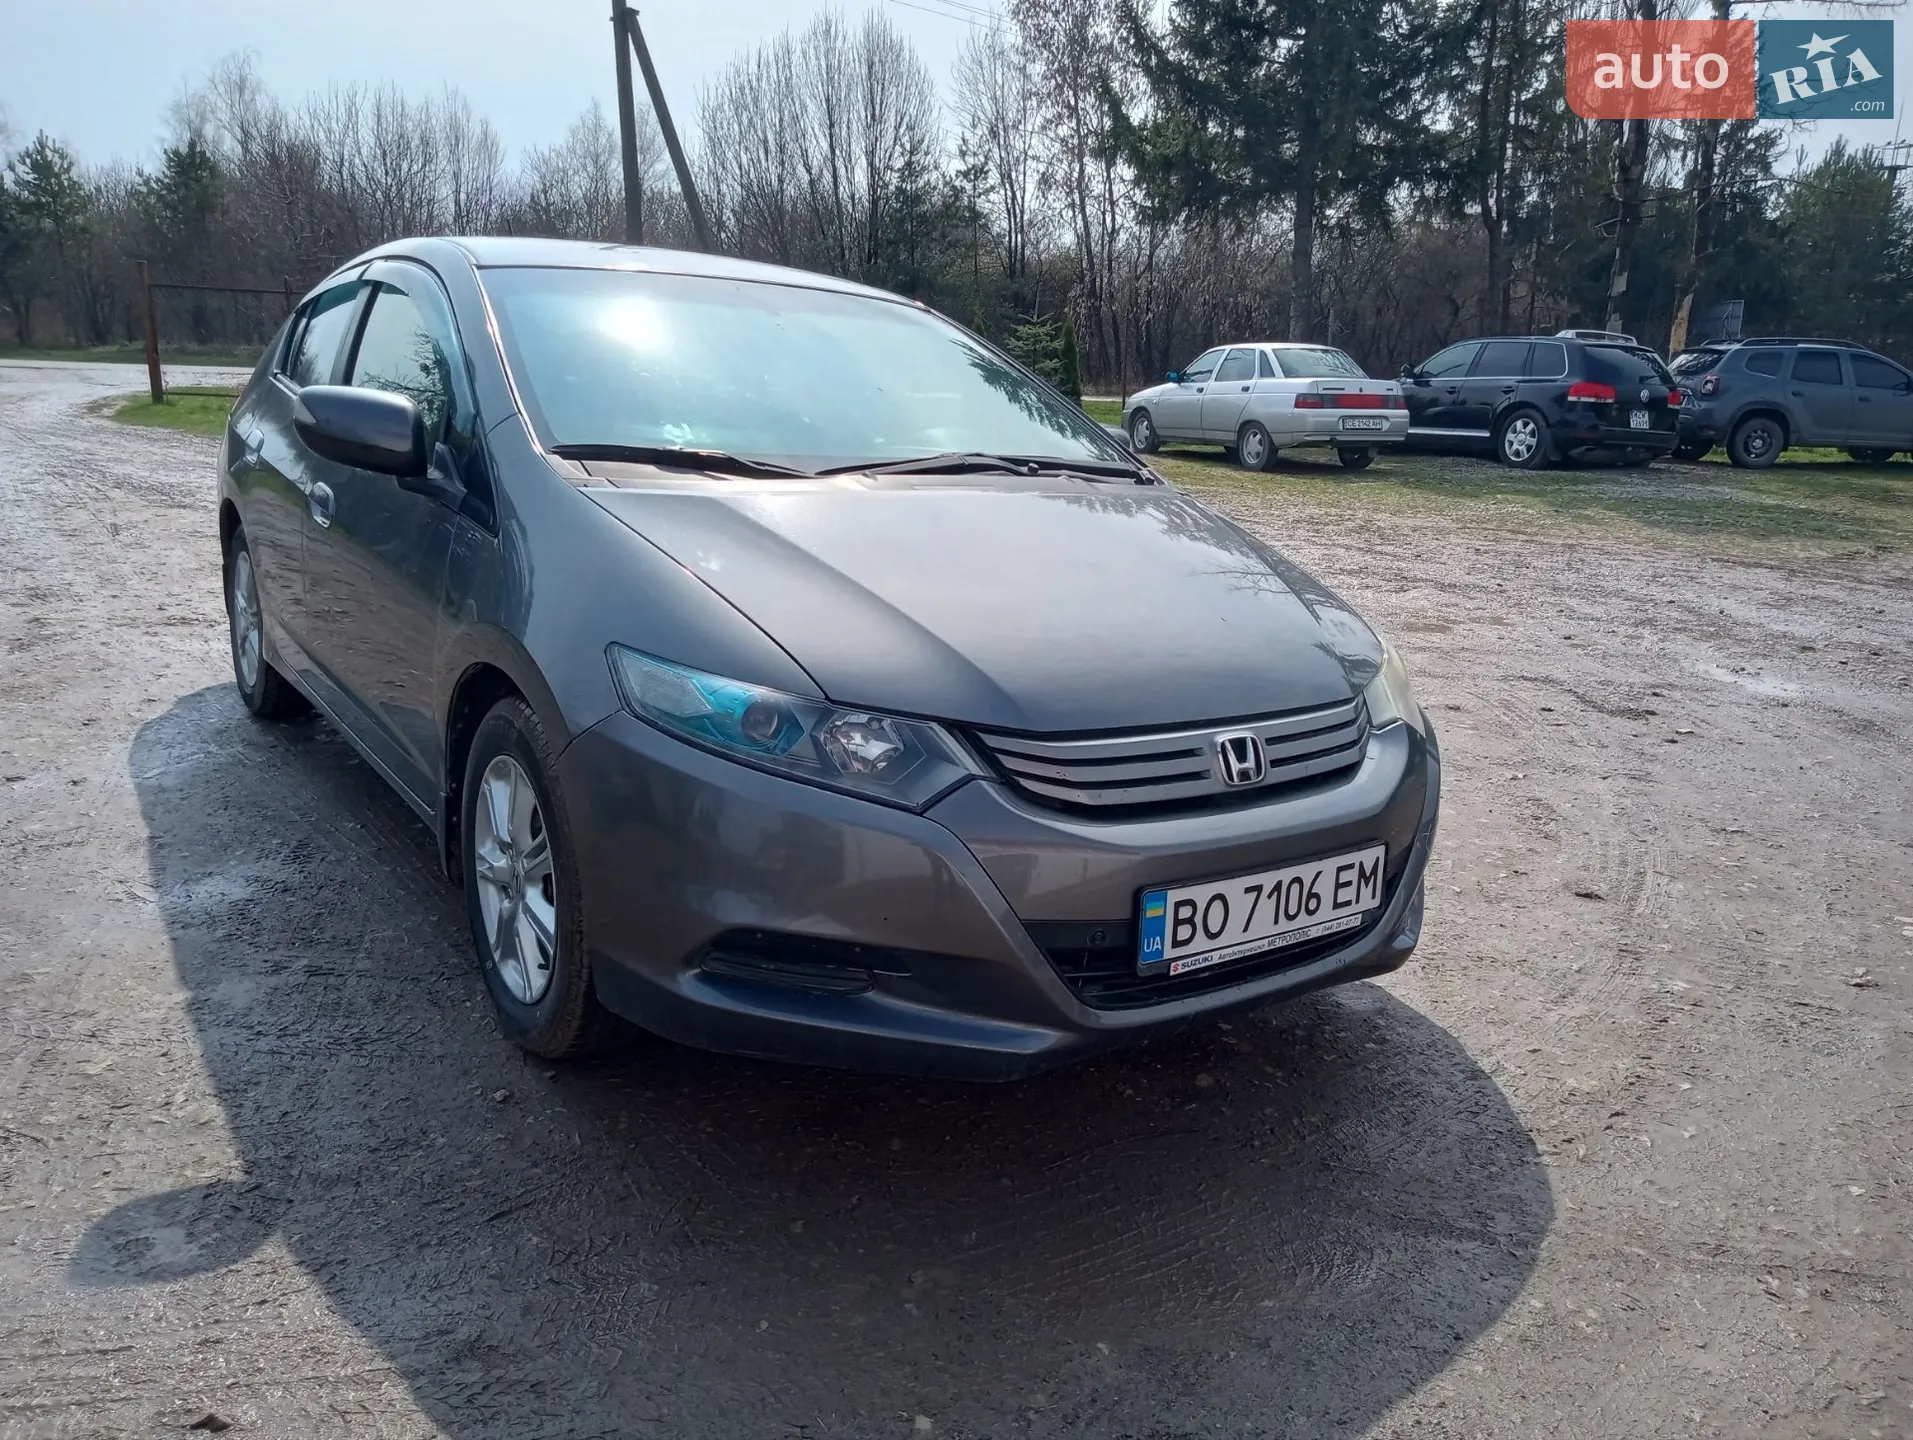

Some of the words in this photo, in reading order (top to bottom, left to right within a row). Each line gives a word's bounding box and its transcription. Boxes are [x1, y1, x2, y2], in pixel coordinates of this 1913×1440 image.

[1171, 892, 1230, 949] BO
[1242, 870, 1323, 933] 7106
[1332, 856, 1380, 911] EM
[1144, 936, 1162, 953] UA
[1181, 954, 1213, 970] SUZUKI
